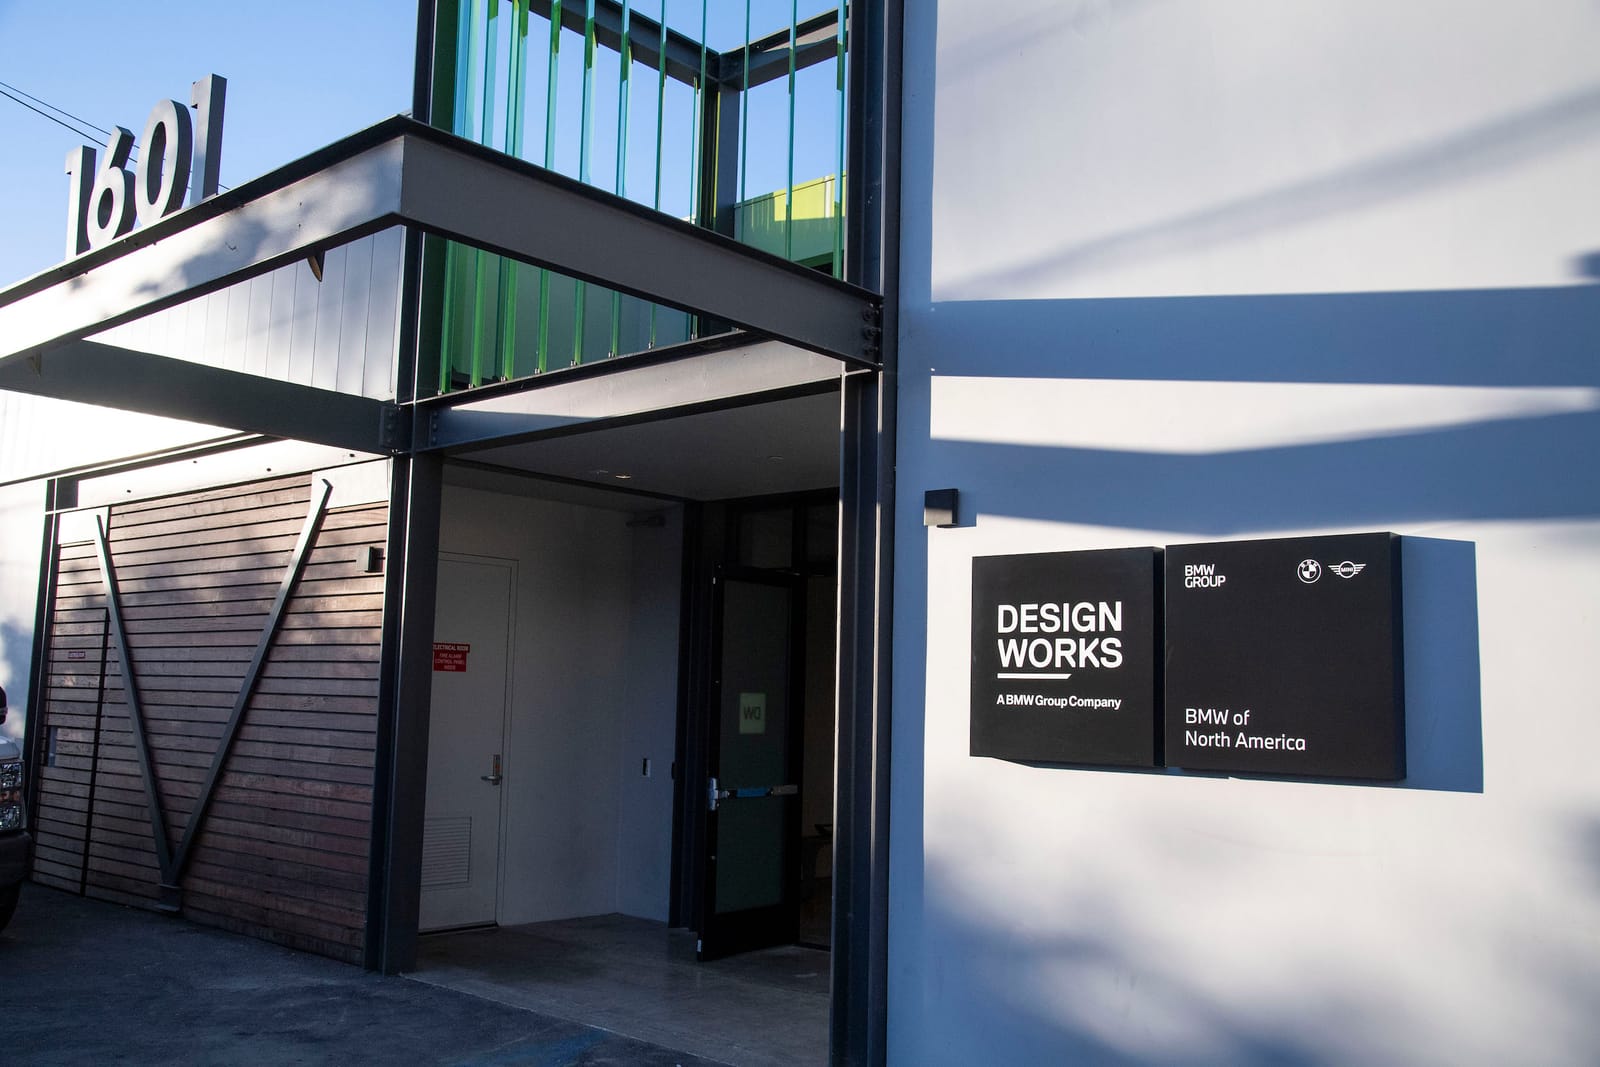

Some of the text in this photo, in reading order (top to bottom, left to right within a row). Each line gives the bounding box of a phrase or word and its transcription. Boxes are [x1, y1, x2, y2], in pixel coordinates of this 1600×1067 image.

[64, 73, 228, 262] 1601
[1184, 564, 1215, 577] BMW
[1184, 575, 1226, 588] GROUP
[997, 601, 1122, 633] DESIGN
[997, 637, 1123, 668] WORKS
[996, 694, 1122, 710] A BMW Group Company
[1185, 708, 1250, 726] BMW of
[1185, 730, 1306, 751] North America
